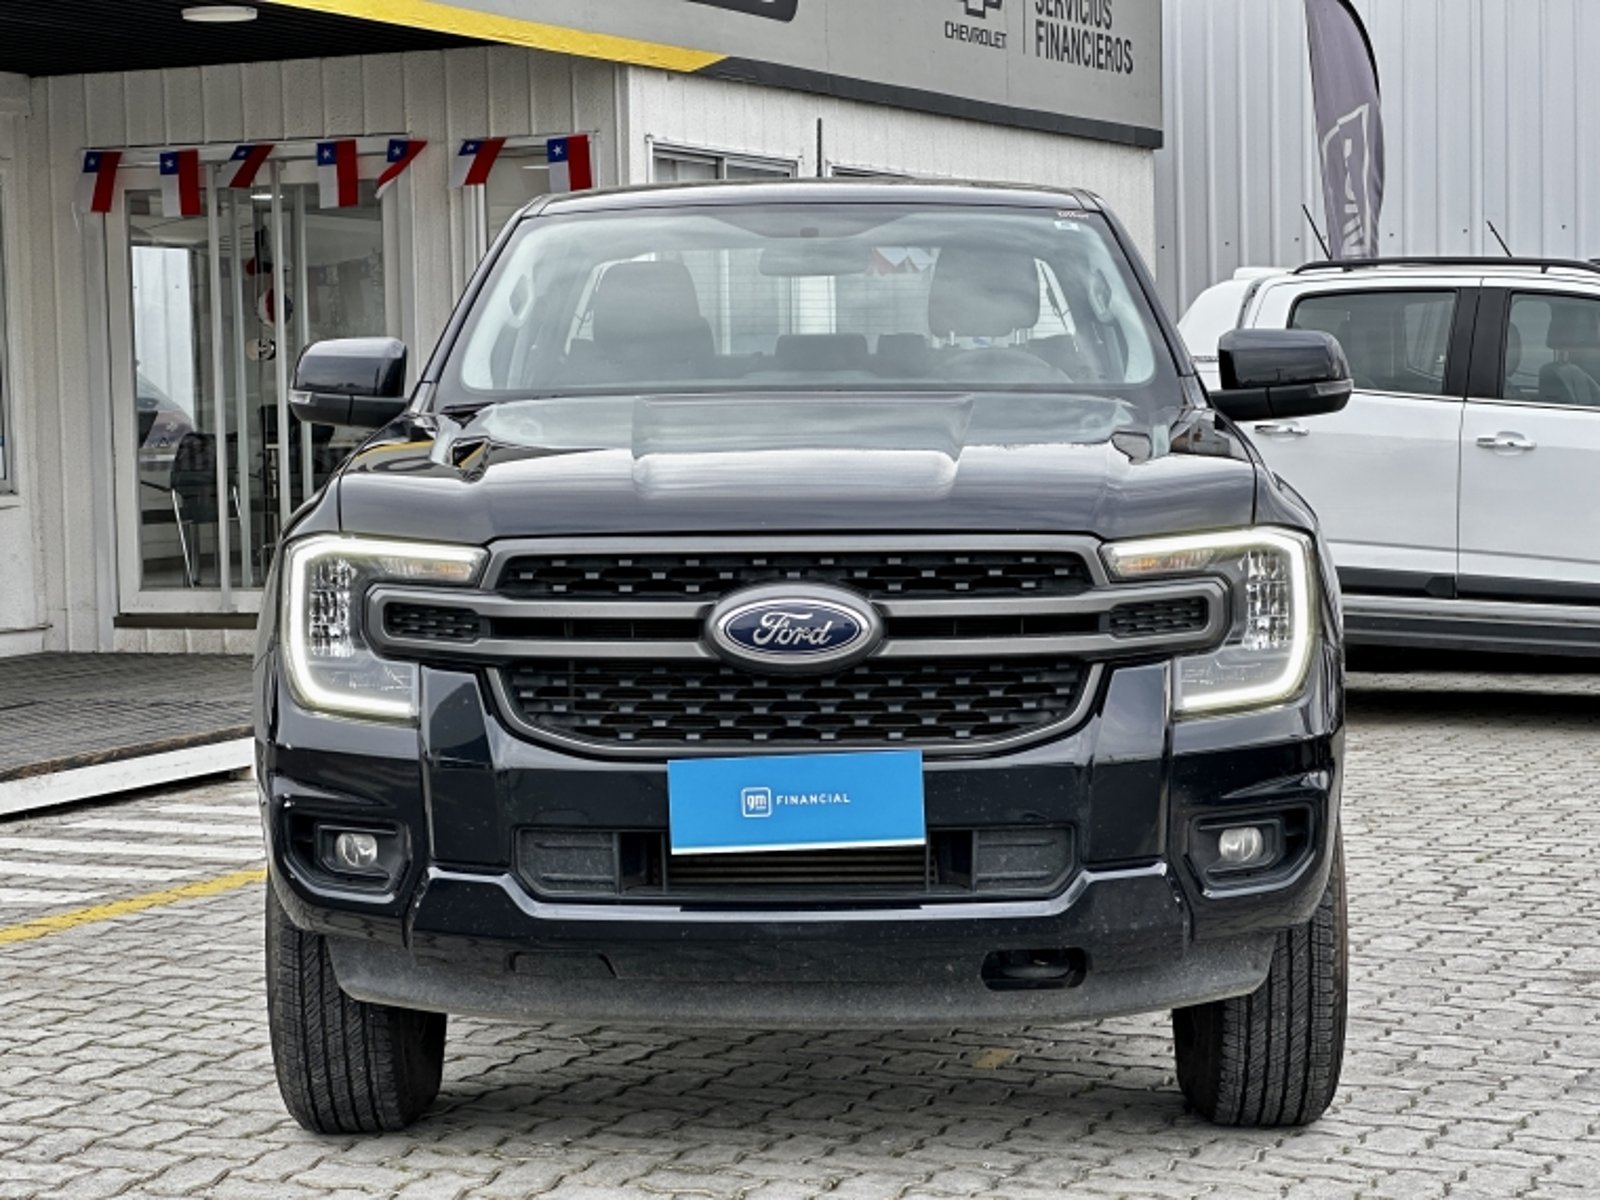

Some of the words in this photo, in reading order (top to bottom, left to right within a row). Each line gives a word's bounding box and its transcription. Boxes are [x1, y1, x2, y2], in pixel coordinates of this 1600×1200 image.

[944, 20, 1007, 49] CHEVROLET
[1035, 19, 1133, 74] FINANCIEROS
[753, 612, 833, 645] Ford
[746, 794, 767, 811] gm
[776, 793, 851, 806] FINANCIAL
